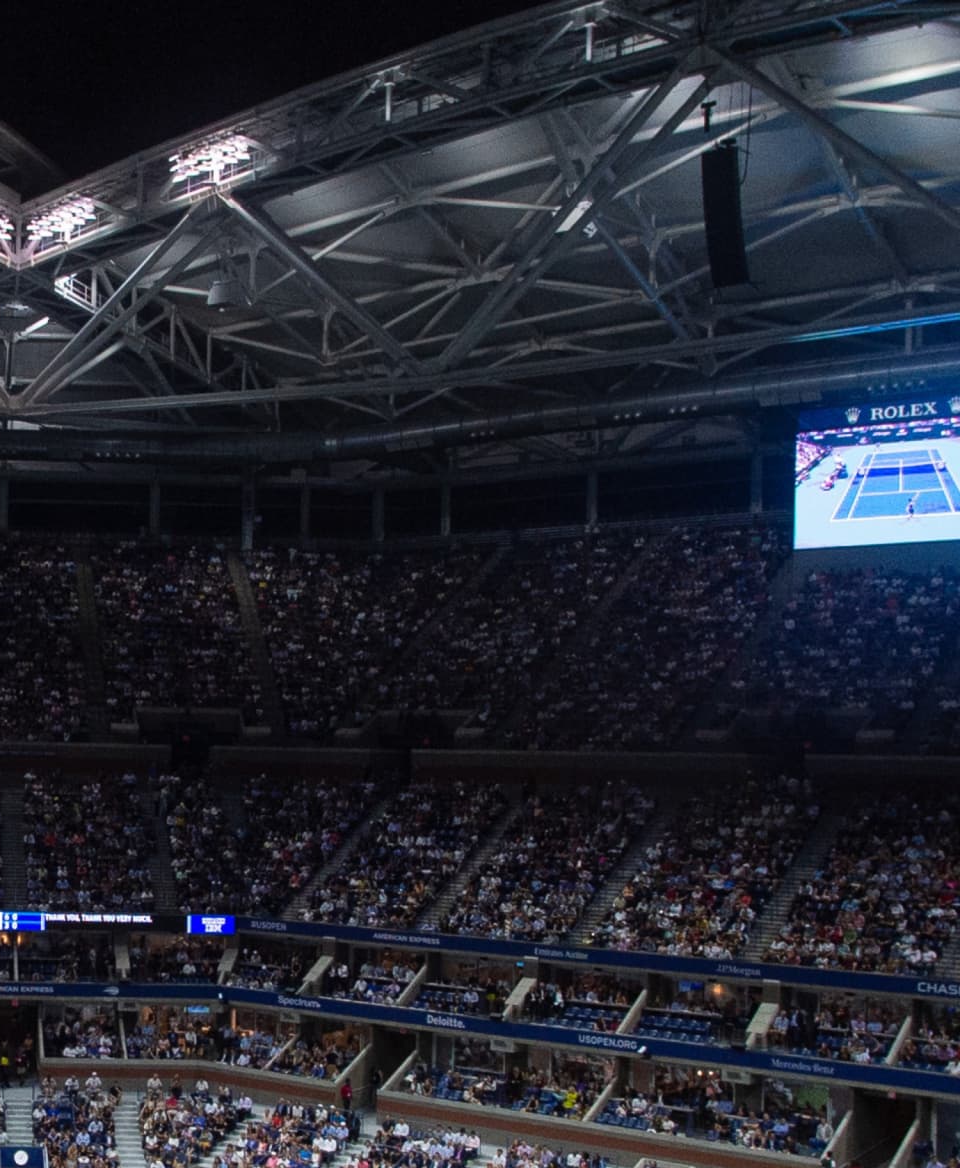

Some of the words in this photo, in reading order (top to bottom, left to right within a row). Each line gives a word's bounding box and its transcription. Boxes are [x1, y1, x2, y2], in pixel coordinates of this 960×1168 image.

[870, 401, 938, 421] ROLEX
[46, 913, 66, 921] THANK
[82, 914, 102, 922] THANK
[103, 914, 116, 922] YOU
[117, 914, 132, 923] VERY
[373, 932, 407, 943] AMERICAN
[409, 935, 440, 945] EXPRESS
[20, 985, 54, 994] EXPRESS
[917, 981, 960, 997] CHAS
[426, 1014, 466, 1029] Deloitte.
[578, 1034, 638, 1050] USOPEN.ORG
